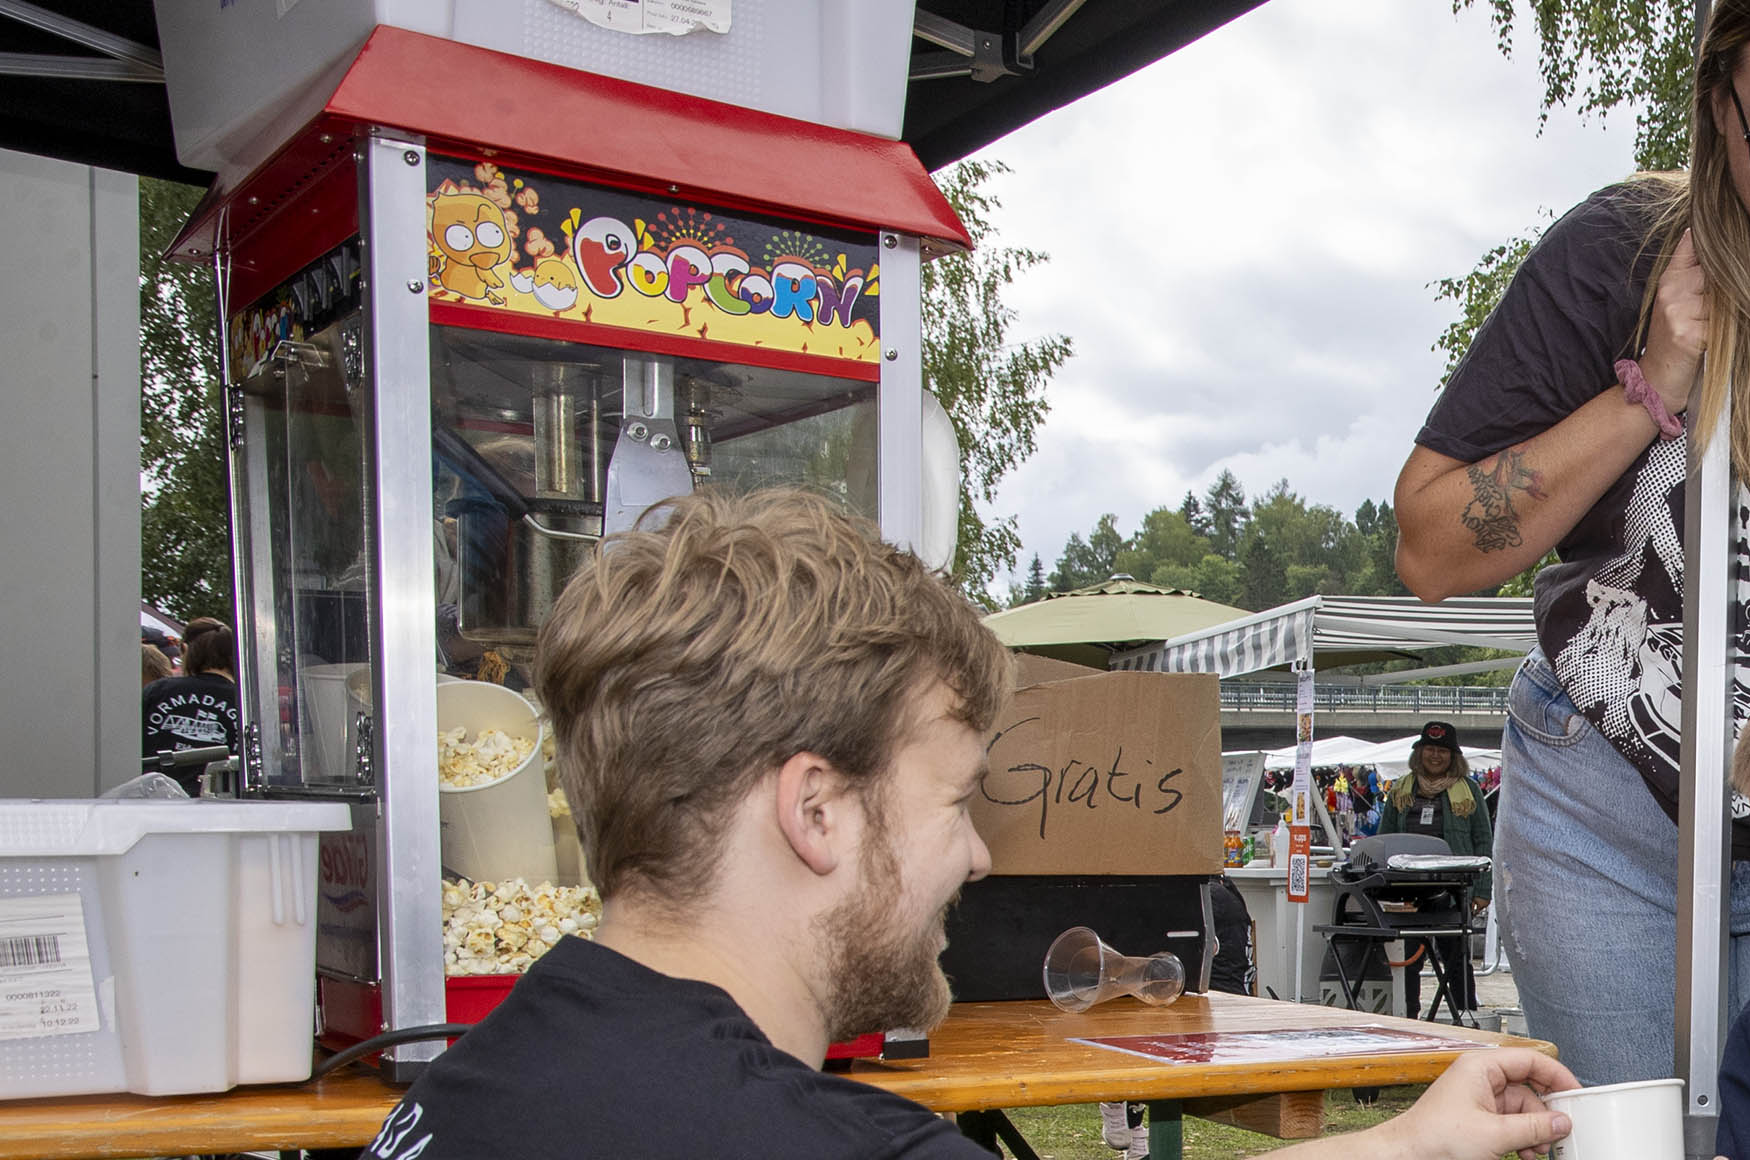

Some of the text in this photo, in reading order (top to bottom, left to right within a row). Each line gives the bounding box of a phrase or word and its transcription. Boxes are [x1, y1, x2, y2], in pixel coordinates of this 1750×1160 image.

[573, 216, 865, 329] POPCORN
[147, 692, 239, 752] VORMADAG
[980, 716, 1184, 840] Gratis
